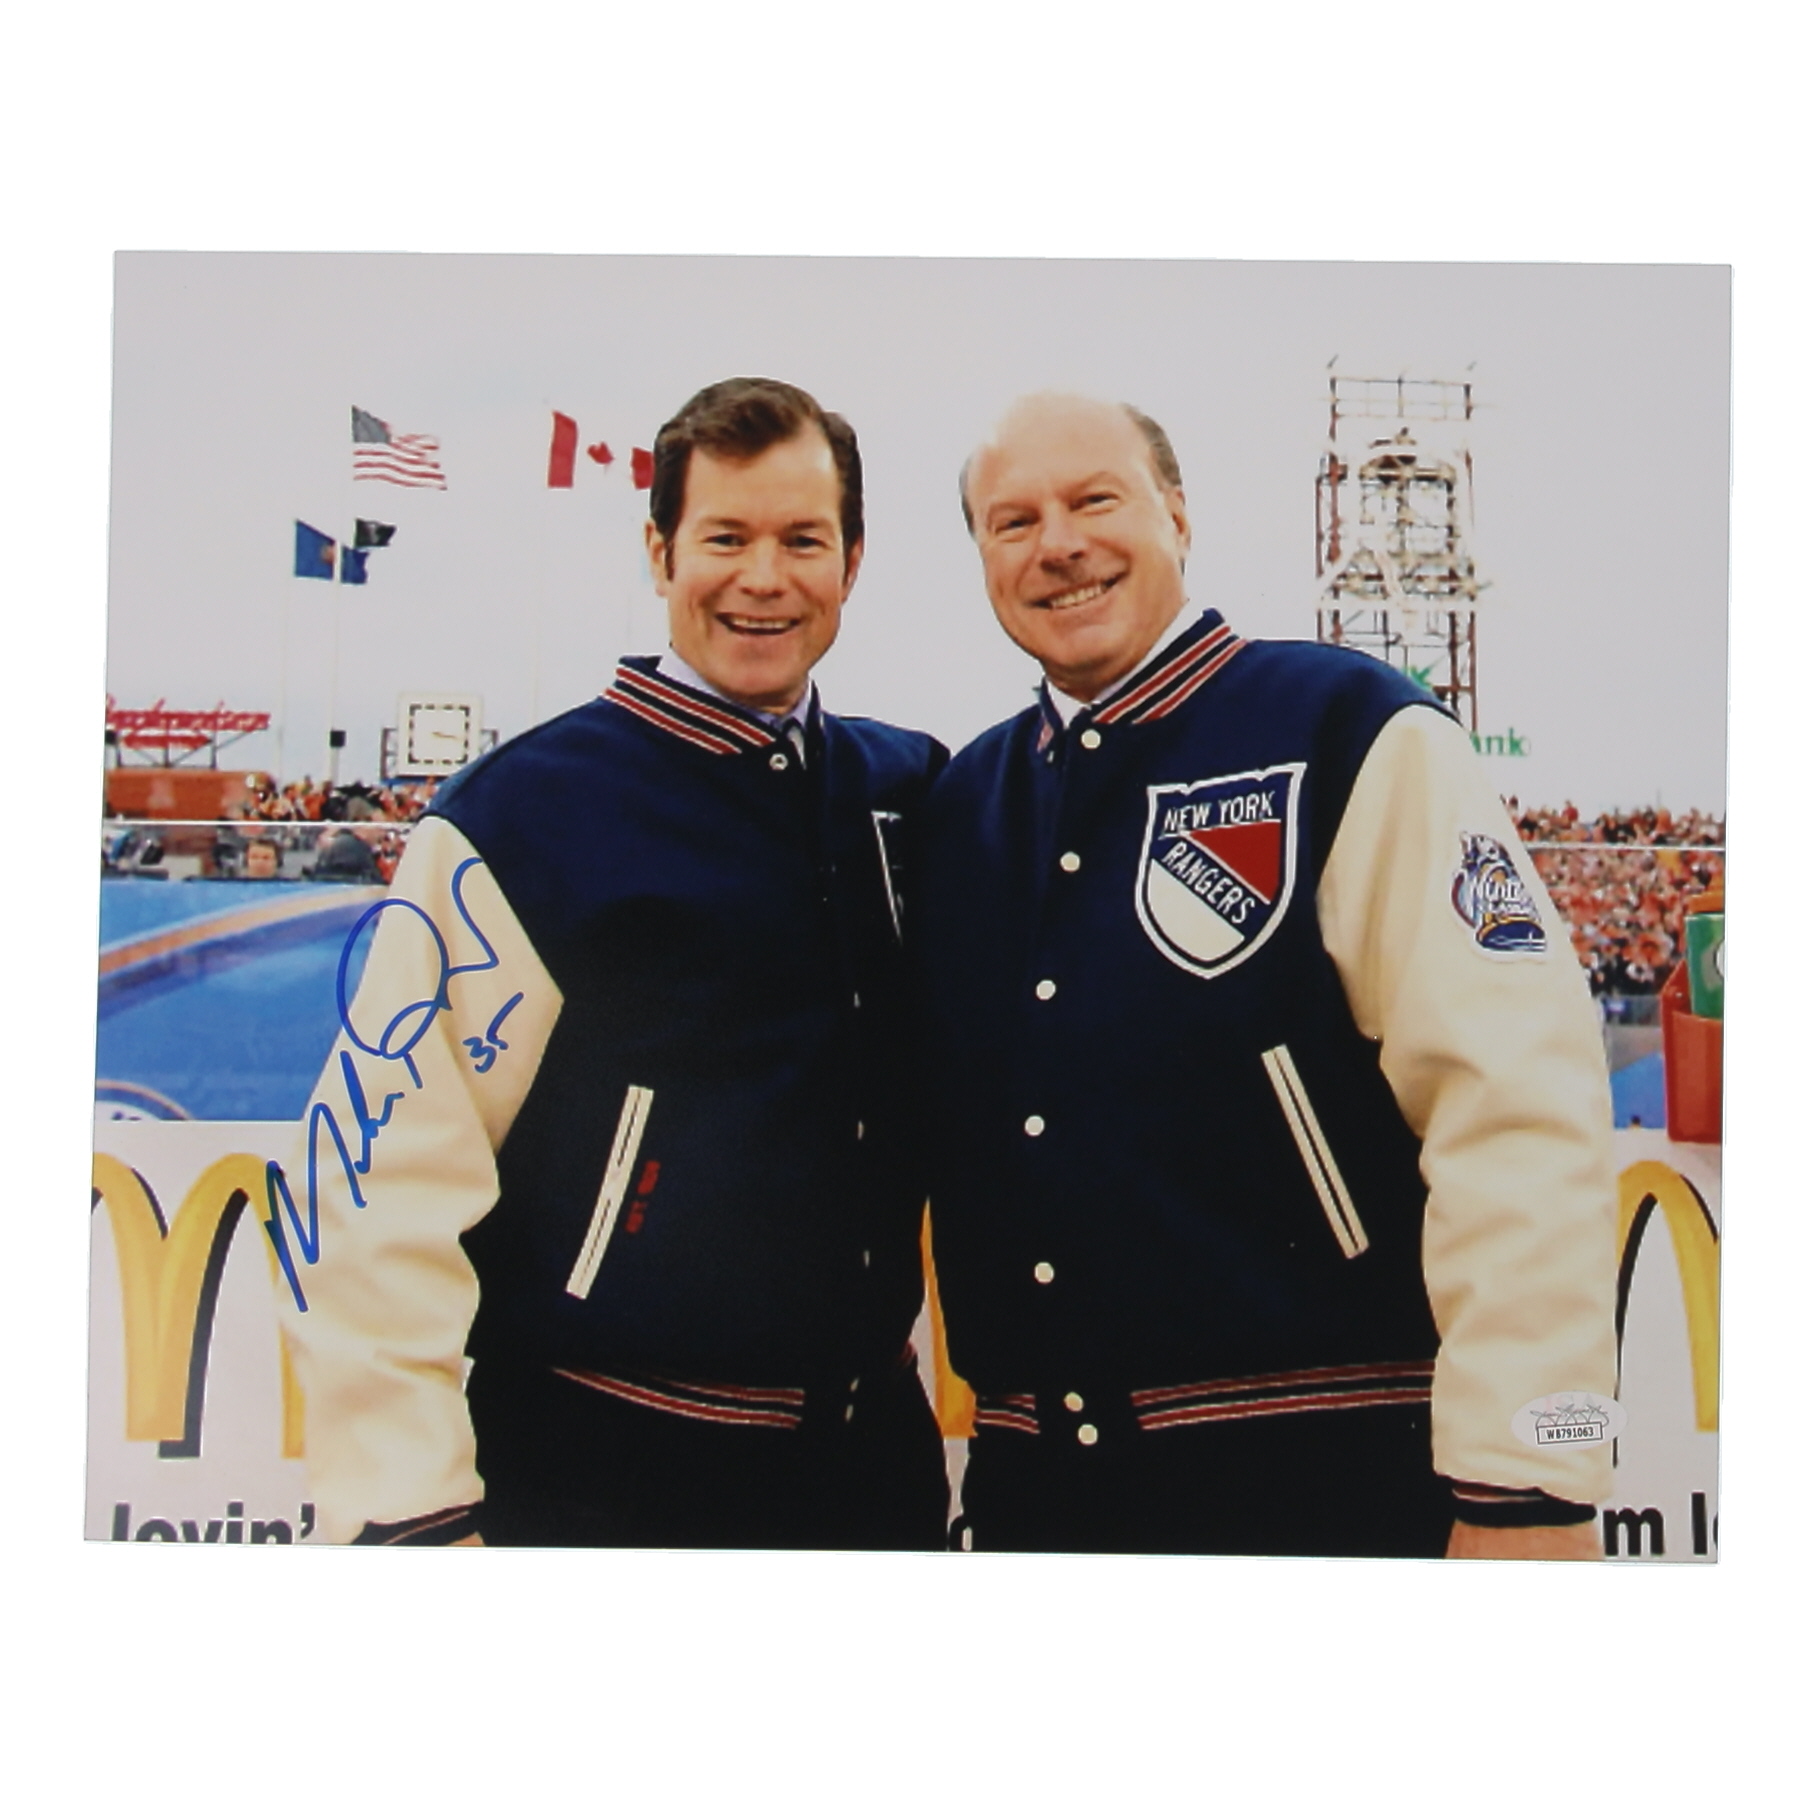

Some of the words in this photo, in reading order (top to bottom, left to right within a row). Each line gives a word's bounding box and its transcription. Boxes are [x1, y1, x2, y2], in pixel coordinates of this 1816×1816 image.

[1163, 802, 1212, 832] NEW
[1217, 790, 1276, 824] YORK
[1160, 841, 1256, 924] RANGERS
